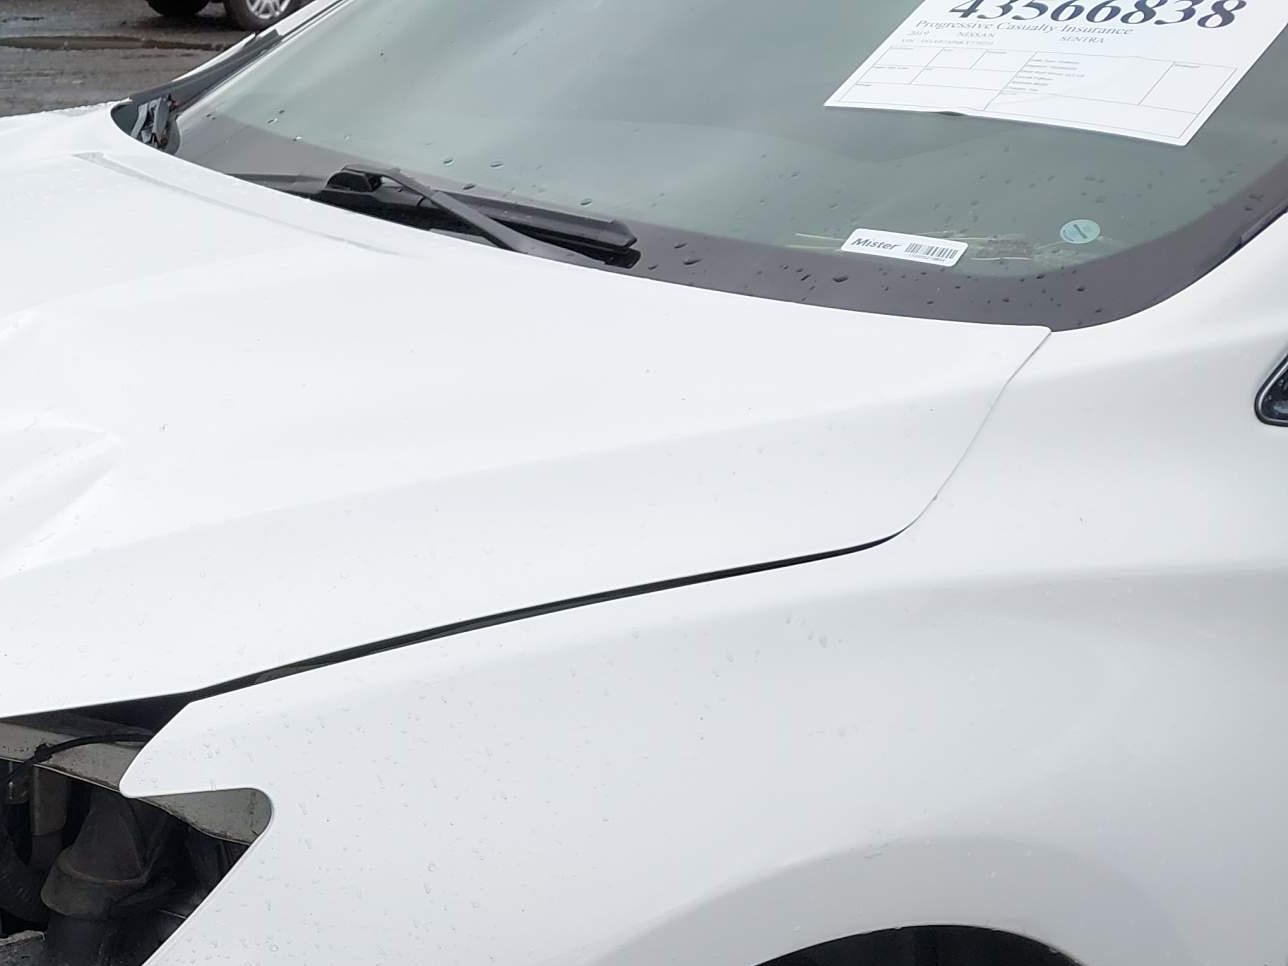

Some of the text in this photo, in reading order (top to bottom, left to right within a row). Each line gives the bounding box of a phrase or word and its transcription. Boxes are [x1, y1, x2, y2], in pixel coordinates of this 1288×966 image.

[949, 0, 1247, 28] 43566838
[915, 19, 1134, 35] Progressive Casualty Insurance
[851, 238, 900, 250] Mister
